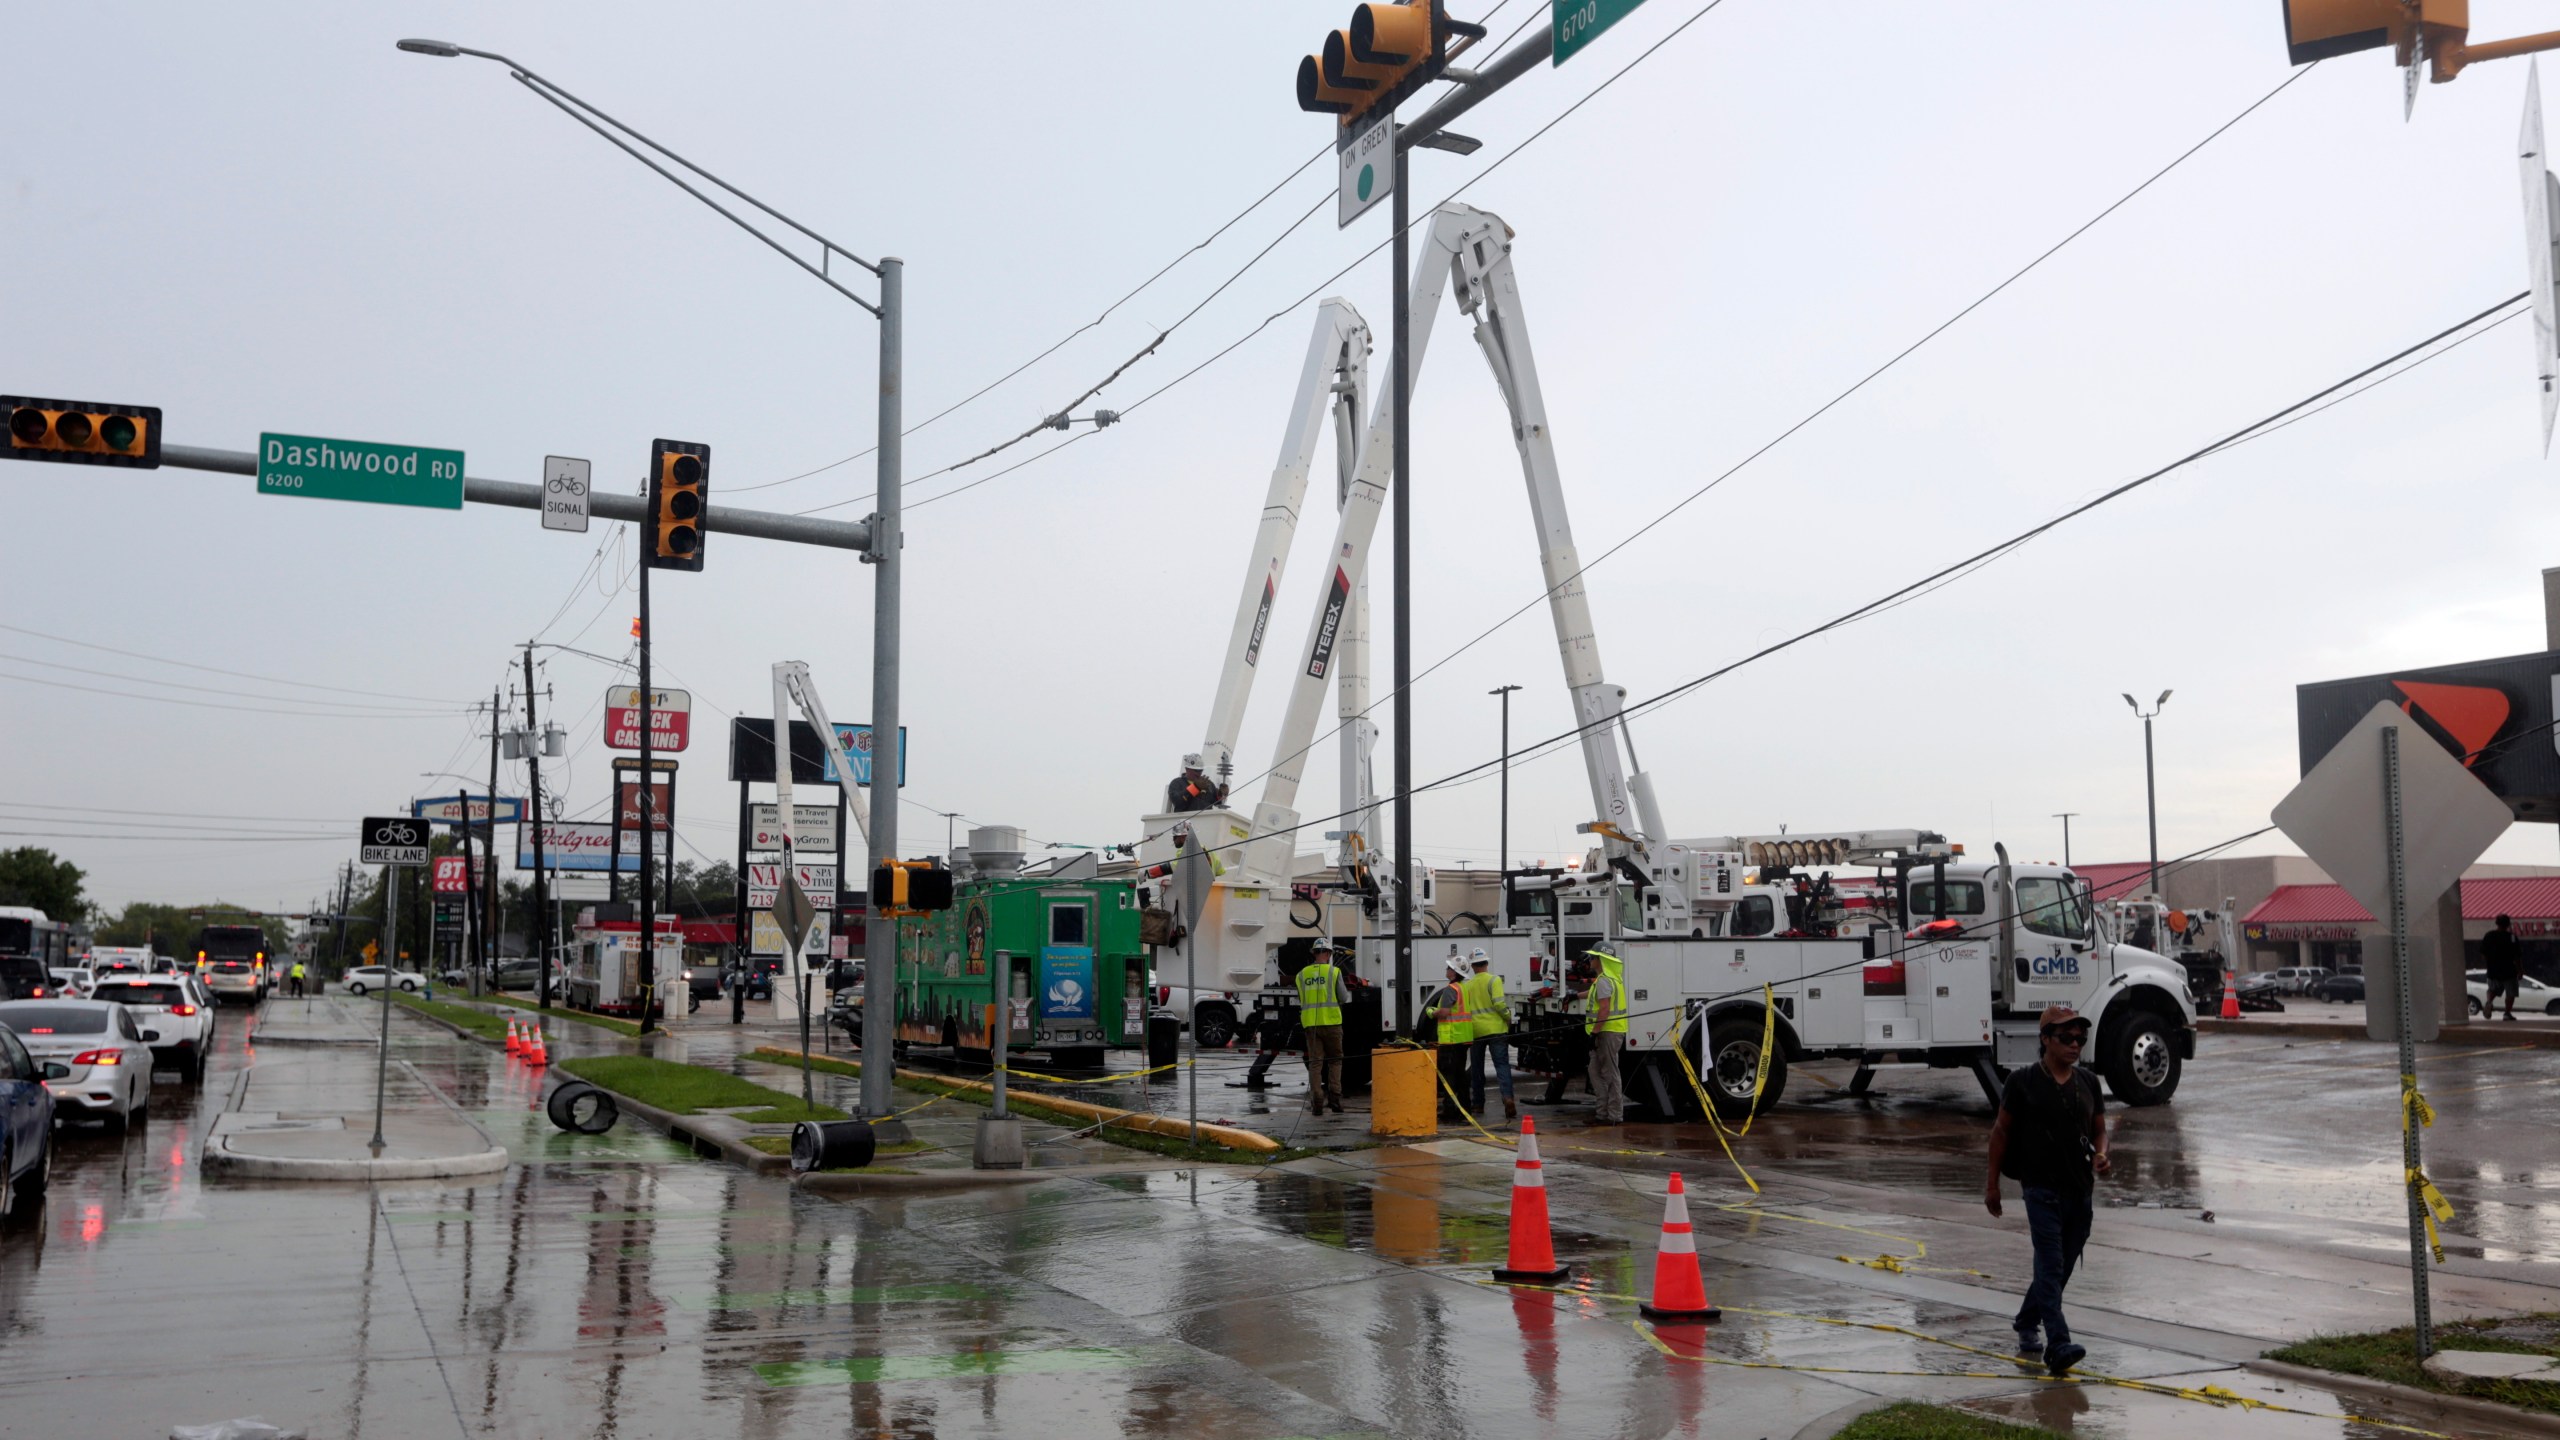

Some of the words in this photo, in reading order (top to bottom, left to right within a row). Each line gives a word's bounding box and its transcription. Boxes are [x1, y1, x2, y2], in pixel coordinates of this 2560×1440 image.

[1562, 0, 1597, 42] 6700
[1345, 146, 1356, 169] ON
[1361, 121, 1388, 156] GREEN
[266, 439, 418, 476] Dashwood
[431, 460, 458, 480] RD
[265, 473, 304, 488] 6200
[547, 500, 585, 516] SIGNAL
[1251, 604, 1269, 647] TEREX
[1315, 602, 1340, 656] TEREX
[622, 710, 673, 729] CHCK
[614, 729, 680, 749] CASING
[805, 809, 828, 817] Travel
[364, 848, 391, 860] BIKE
[395, 849, 424, 861] LANE
[815, 867, 832, 877] SPA
[811, 877, 835, 887] TIME
[751, 894, 773, 906] 713
[2246, 928, 2263, 939] RAC
[2032, 957, 2080, 975] GMB
[1304, 976, 1326, 986] GMB
